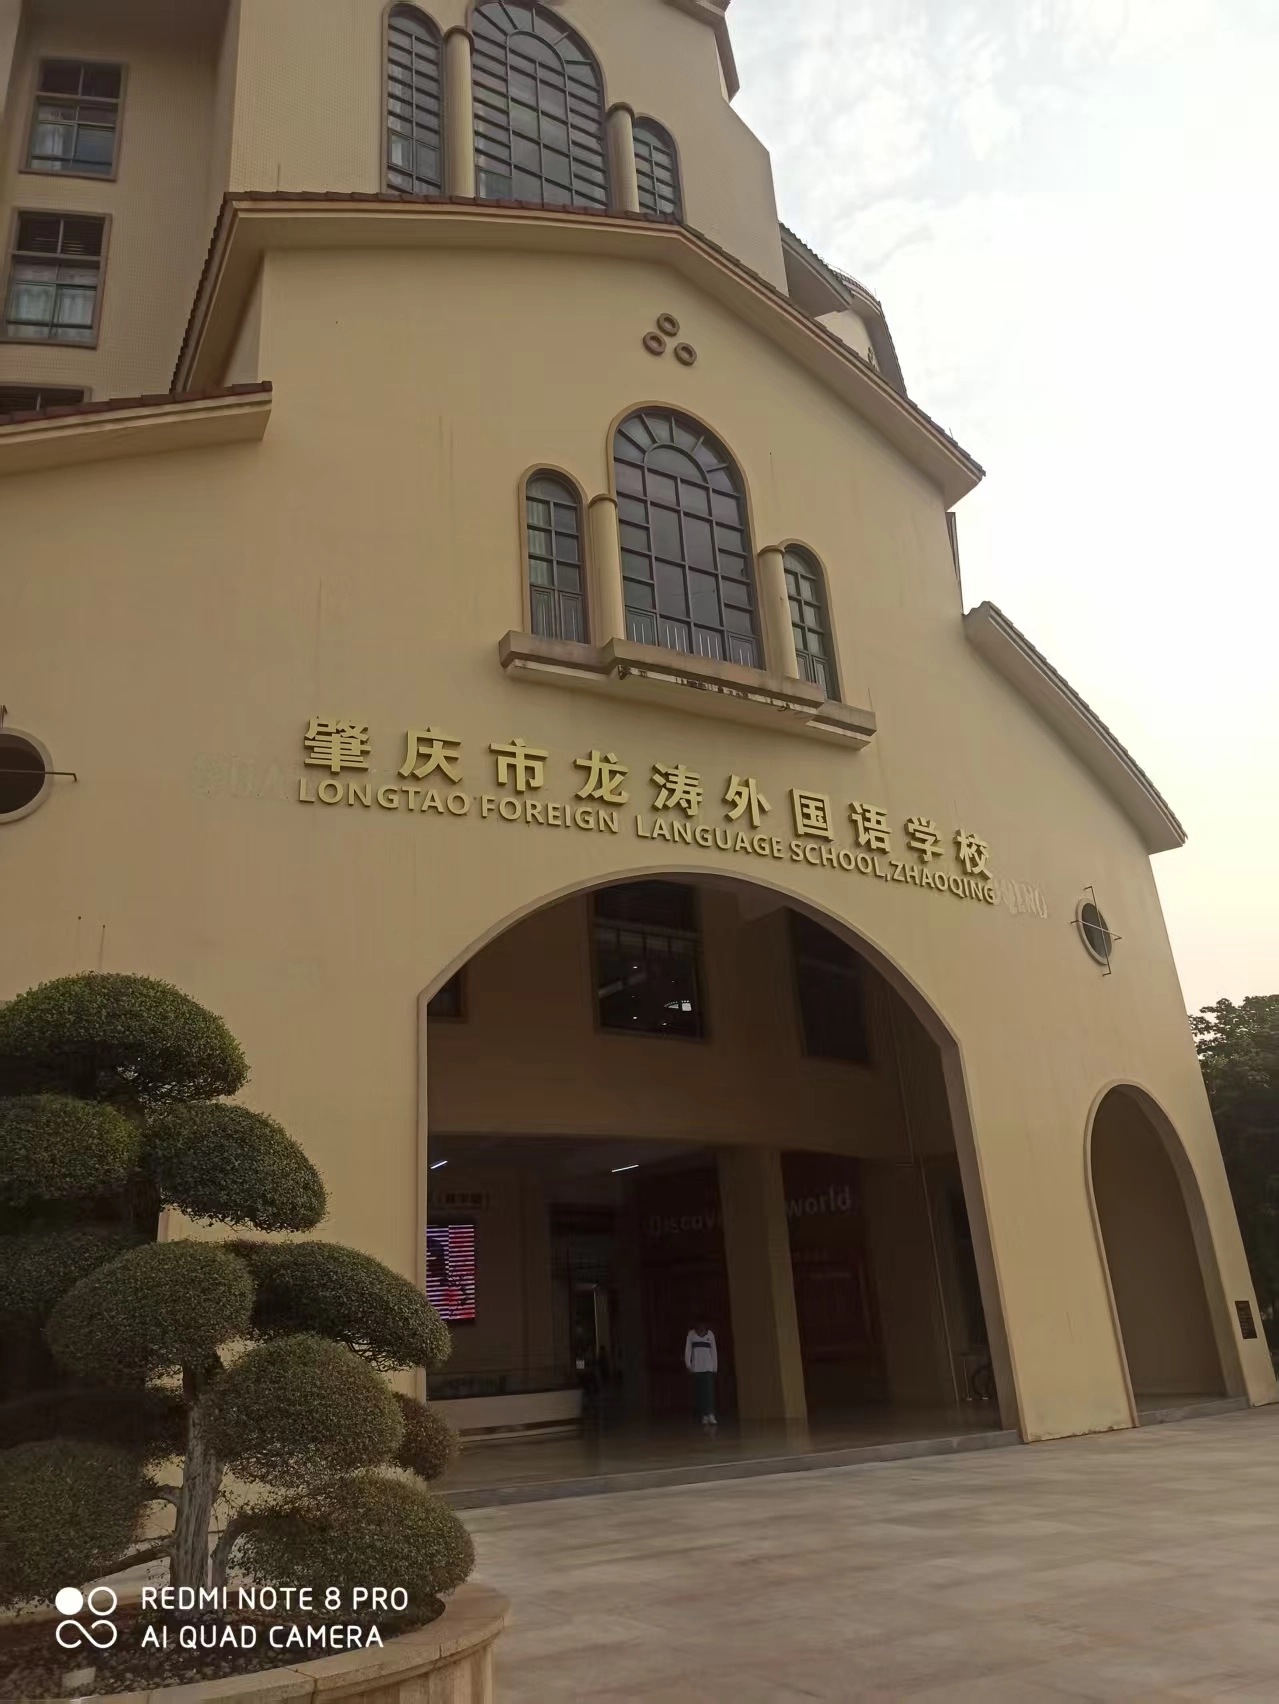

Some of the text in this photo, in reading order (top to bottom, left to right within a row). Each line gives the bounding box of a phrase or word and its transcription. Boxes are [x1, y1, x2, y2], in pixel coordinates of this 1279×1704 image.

[298, 777, 471, 818] LONGTAO
[480, 794, 620, 834] FOREIGN
[635, 813, 785, 859] LANGUAGE
[304, 715, 993, 880] 肇庆市龙涛外国语学校
[785, 1184, 853, 1218] world
